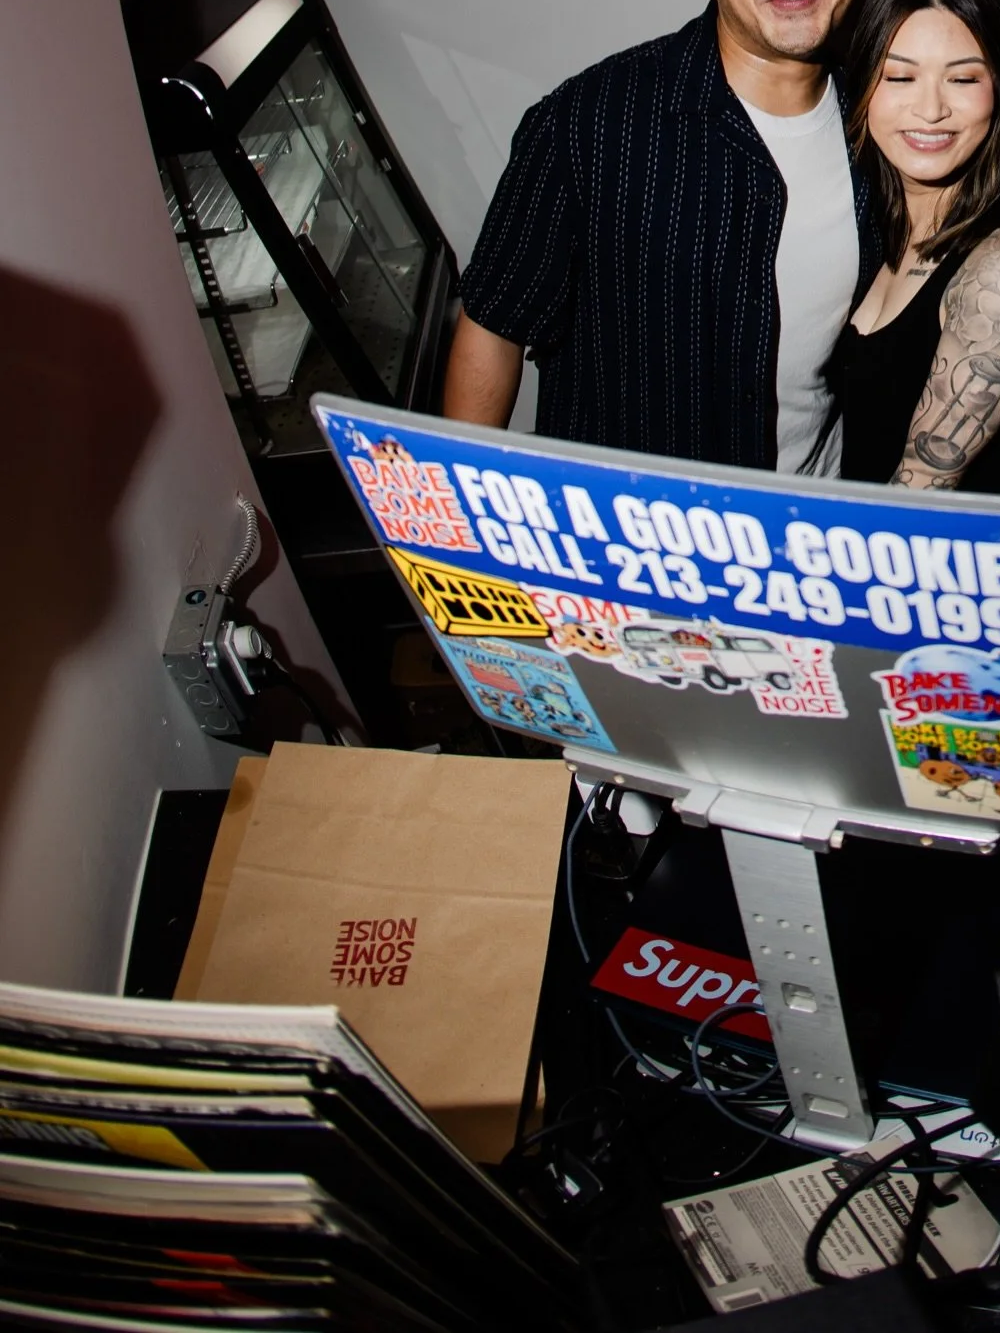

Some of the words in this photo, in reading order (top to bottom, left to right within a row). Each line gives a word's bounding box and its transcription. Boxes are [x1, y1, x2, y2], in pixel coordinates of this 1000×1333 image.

[352, 460, 452, 492] BAKE
[366, 488, 466, 522] SOME
[452, 462, 559, 533] FOR
[562, 484, 610, 544] A
[612, 494, 771, 568] GOOD
[379, 516, 479, 549] NOISE
[476, 516, 604, 585] CALL
[440, 596, 542, 626] NOISE
[881, 672, 972, 698] BAKE
[761, 696, 842, 715] NOISE
[339, 916, 418, 943] NOISE
[333, 940, 415, 966] SOME
[328, 964, 408, 987] BAKE
[884, 1193, 900, 1210] ART
